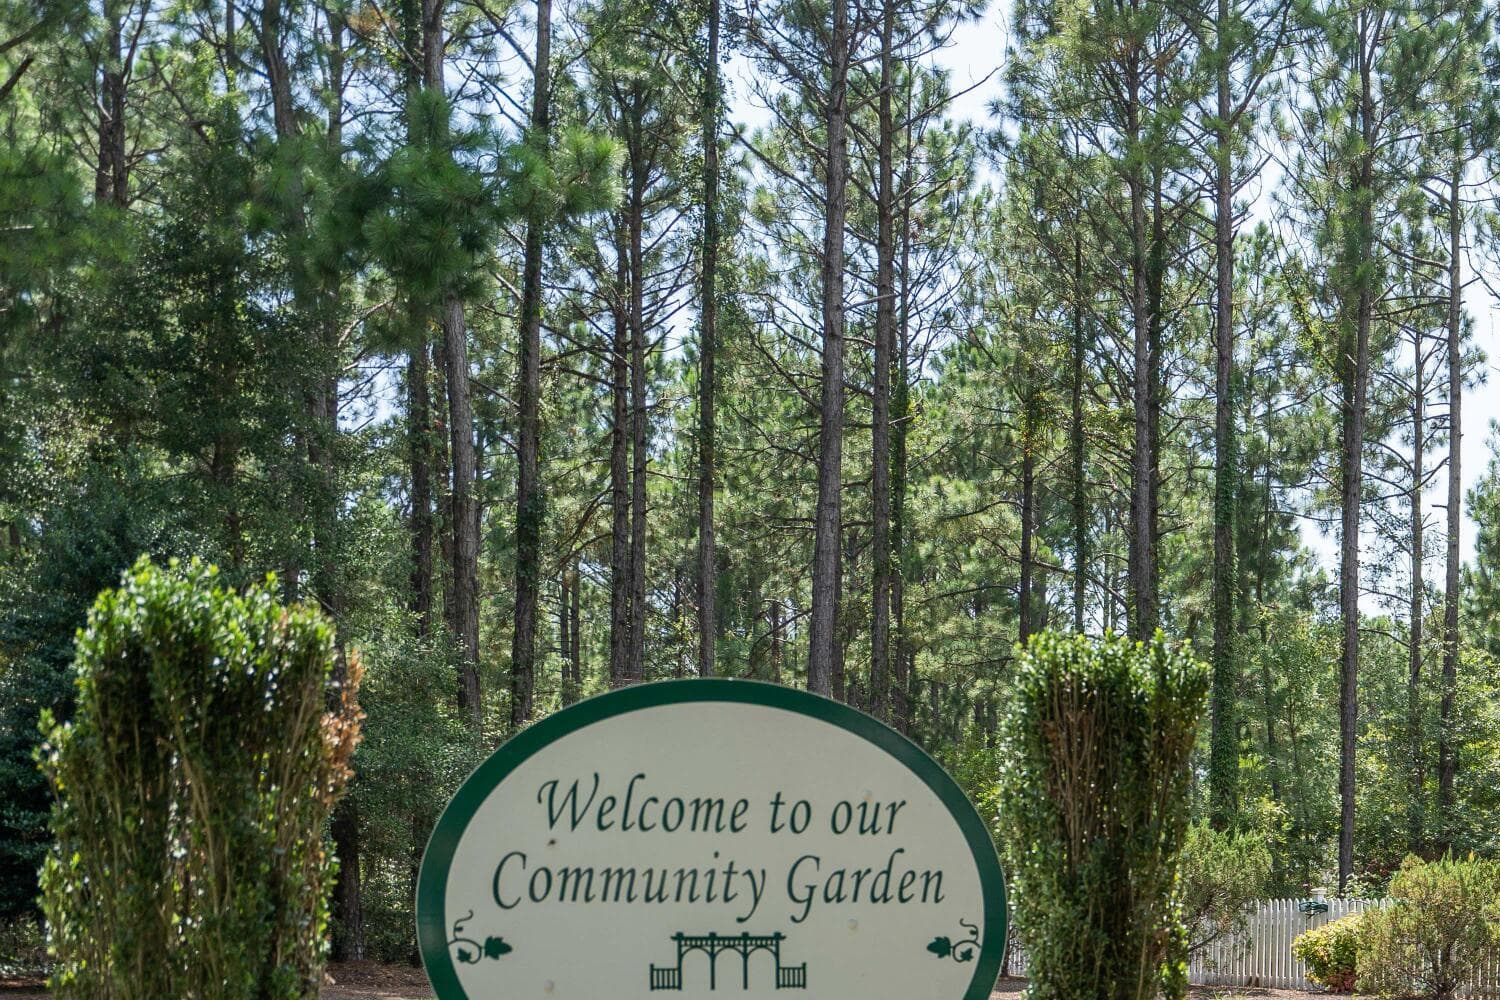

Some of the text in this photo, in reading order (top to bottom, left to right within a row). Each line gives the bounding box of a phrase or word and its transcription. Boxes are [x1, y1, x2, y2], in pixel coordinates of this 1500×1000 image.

[537, 773, 906, 836] Welcome to our
[492, 848, 945, 924] Community Garden
